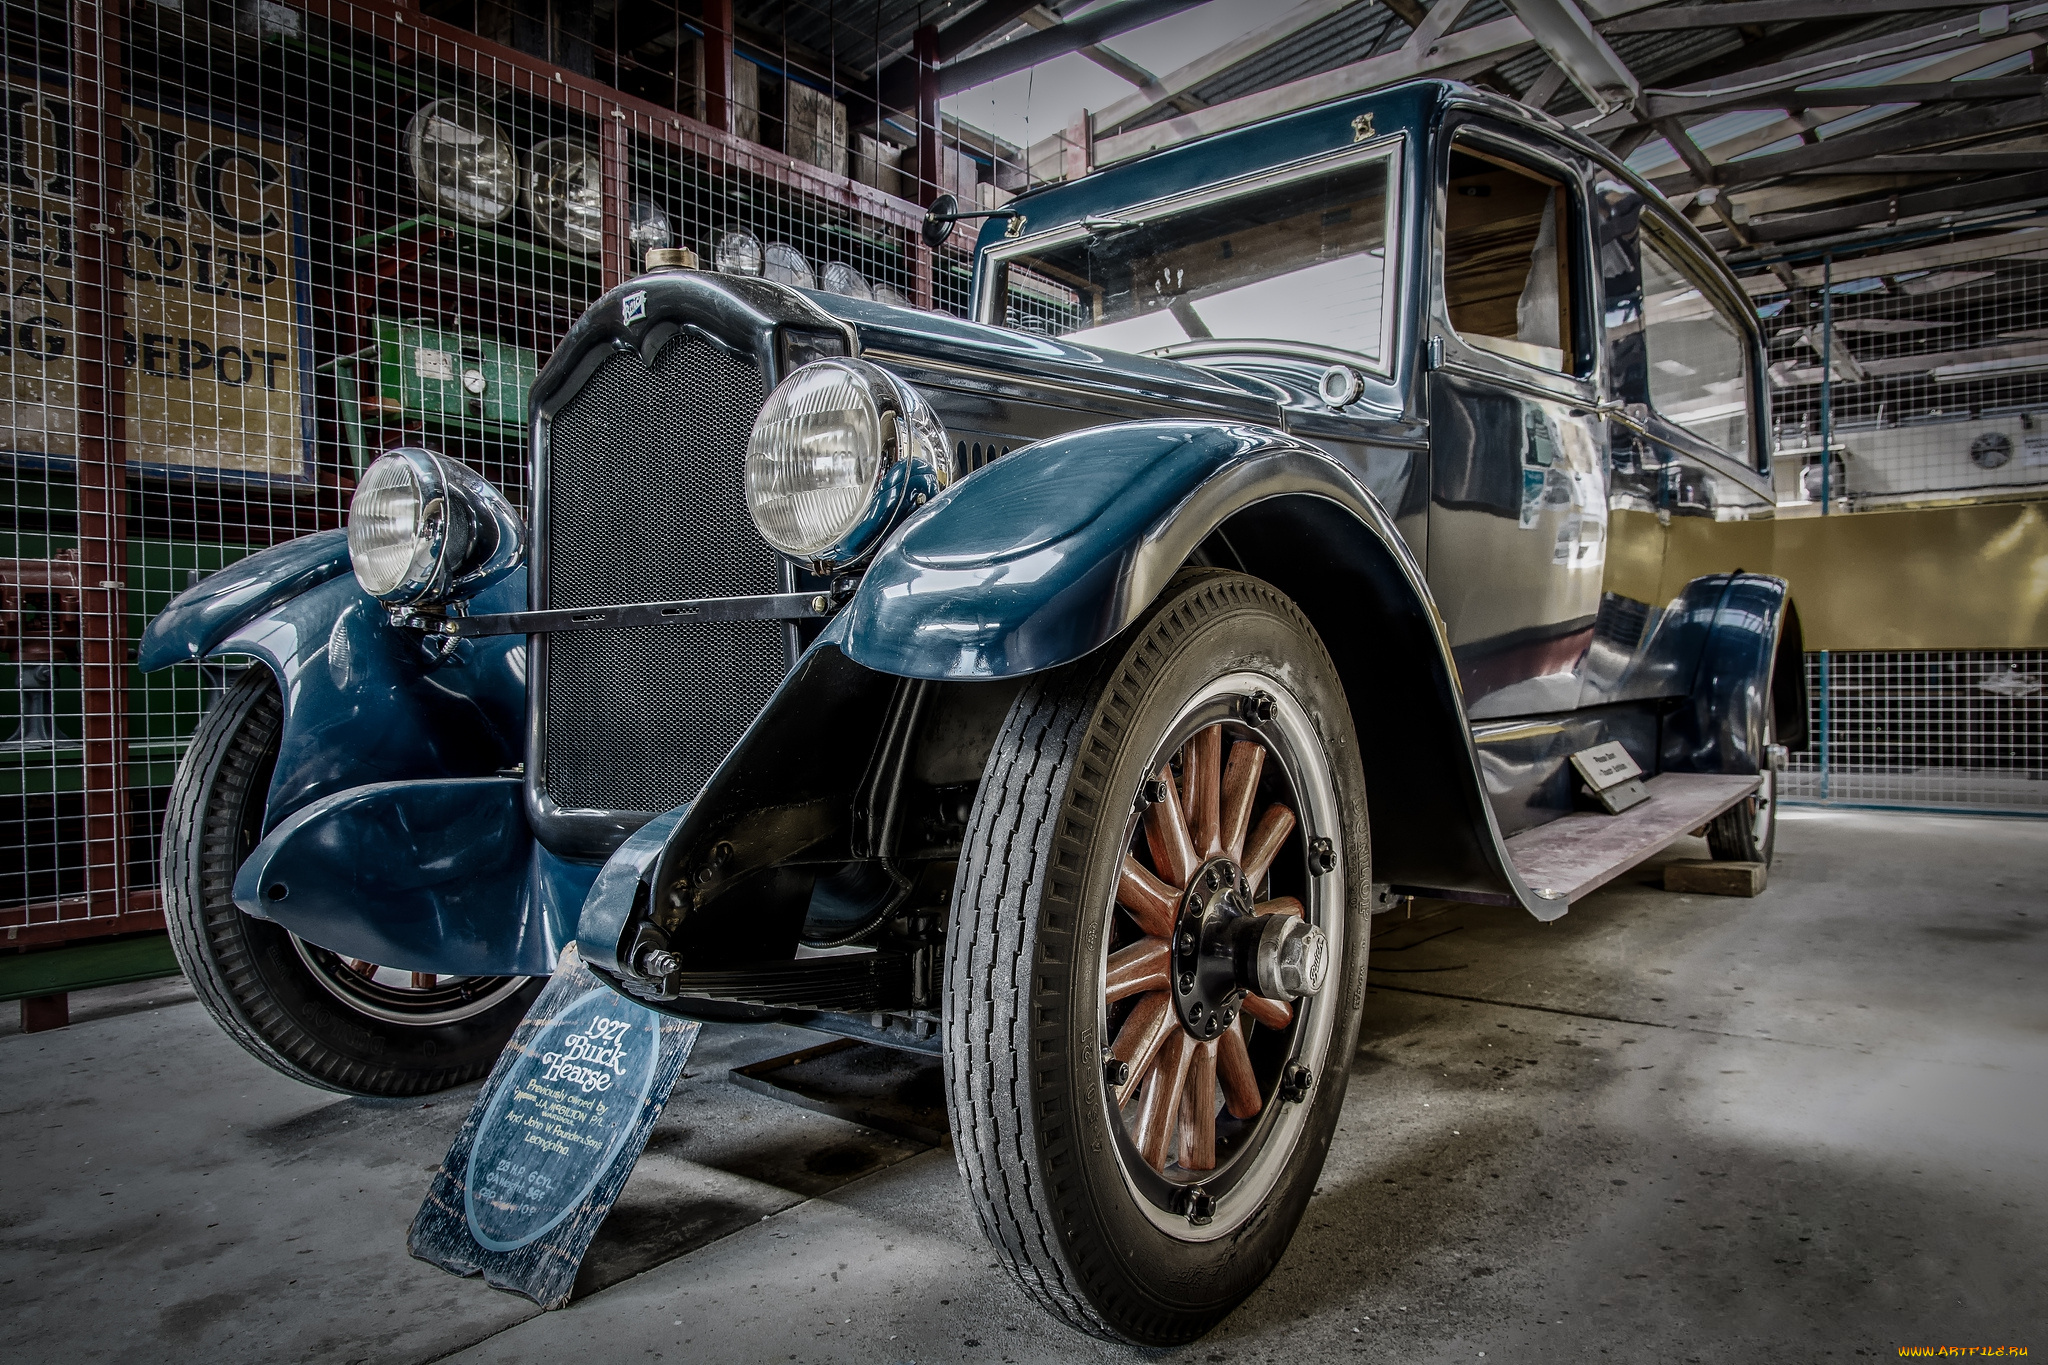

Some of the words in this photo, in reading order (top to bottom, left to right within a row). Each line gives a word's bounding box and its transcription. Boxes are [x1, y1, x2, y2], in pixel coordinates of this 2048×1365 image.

[190, 241, 279, 304] LTD
[585, 1015, 631, 1044] 1927
[542, 1051, 612, 1092] Hearse
[561, 1034, 628, 1076] Buick
[526, 1078, 567, 1103] Previously
[567, 1095, 596, 1111] owned
[595, 1100, 609, 1116] by
[504, 1110, 525, 1125] And
[523, 1115, 544, 1131] John
[528, 1170, 538, 1183] 6
